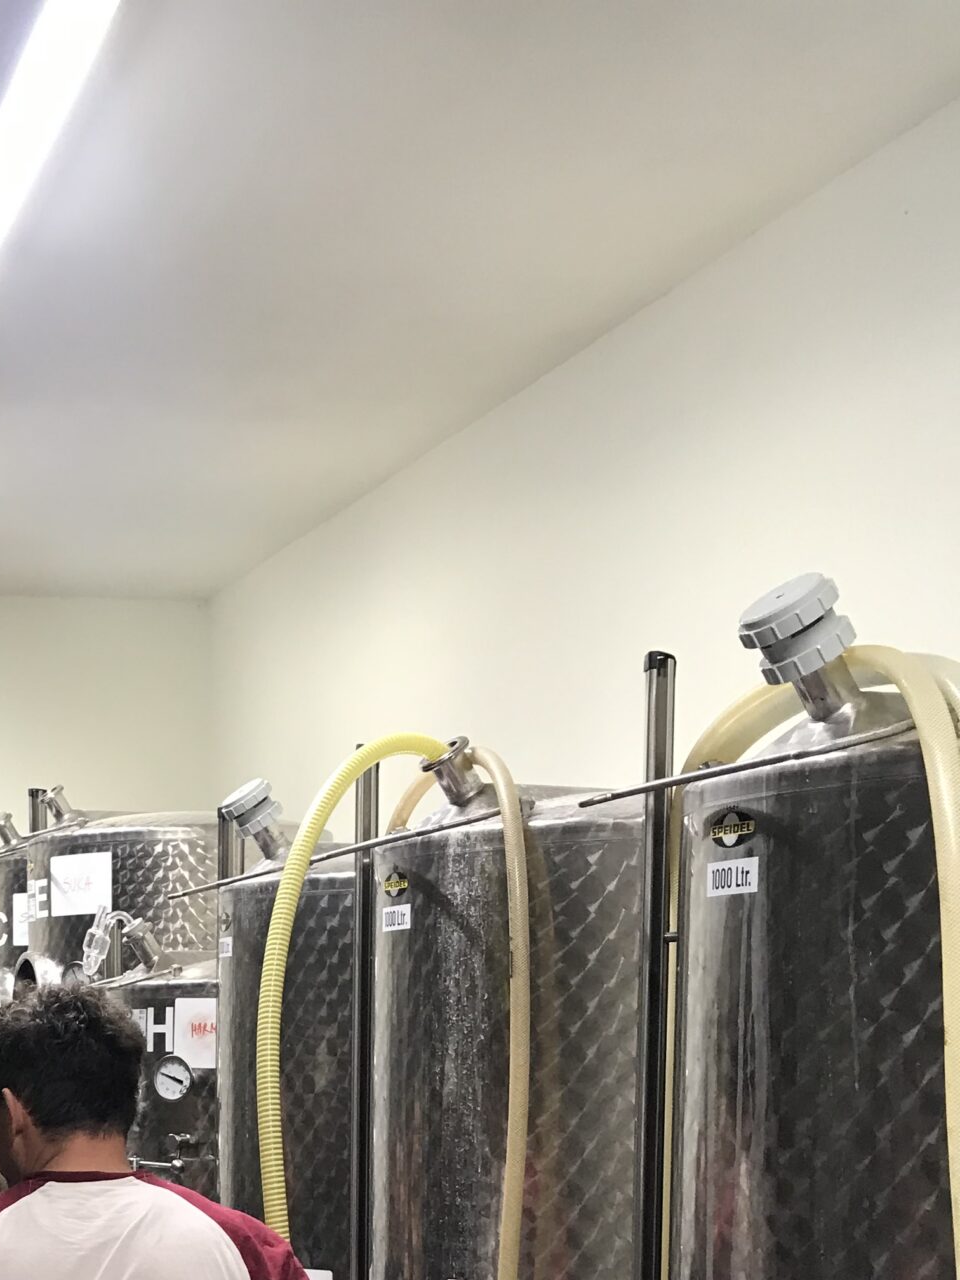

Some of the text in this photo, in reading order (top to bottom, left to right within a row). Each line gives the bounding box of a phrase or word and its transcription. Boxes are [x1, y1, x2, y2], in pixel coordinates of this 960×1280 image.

[711, 822, 753, 837] SPEIDEL
[711, 865, 752, 891] 1000 Ltr.
[35, 878, 49, 919] E
[146, 1006, 174, 1053] H
